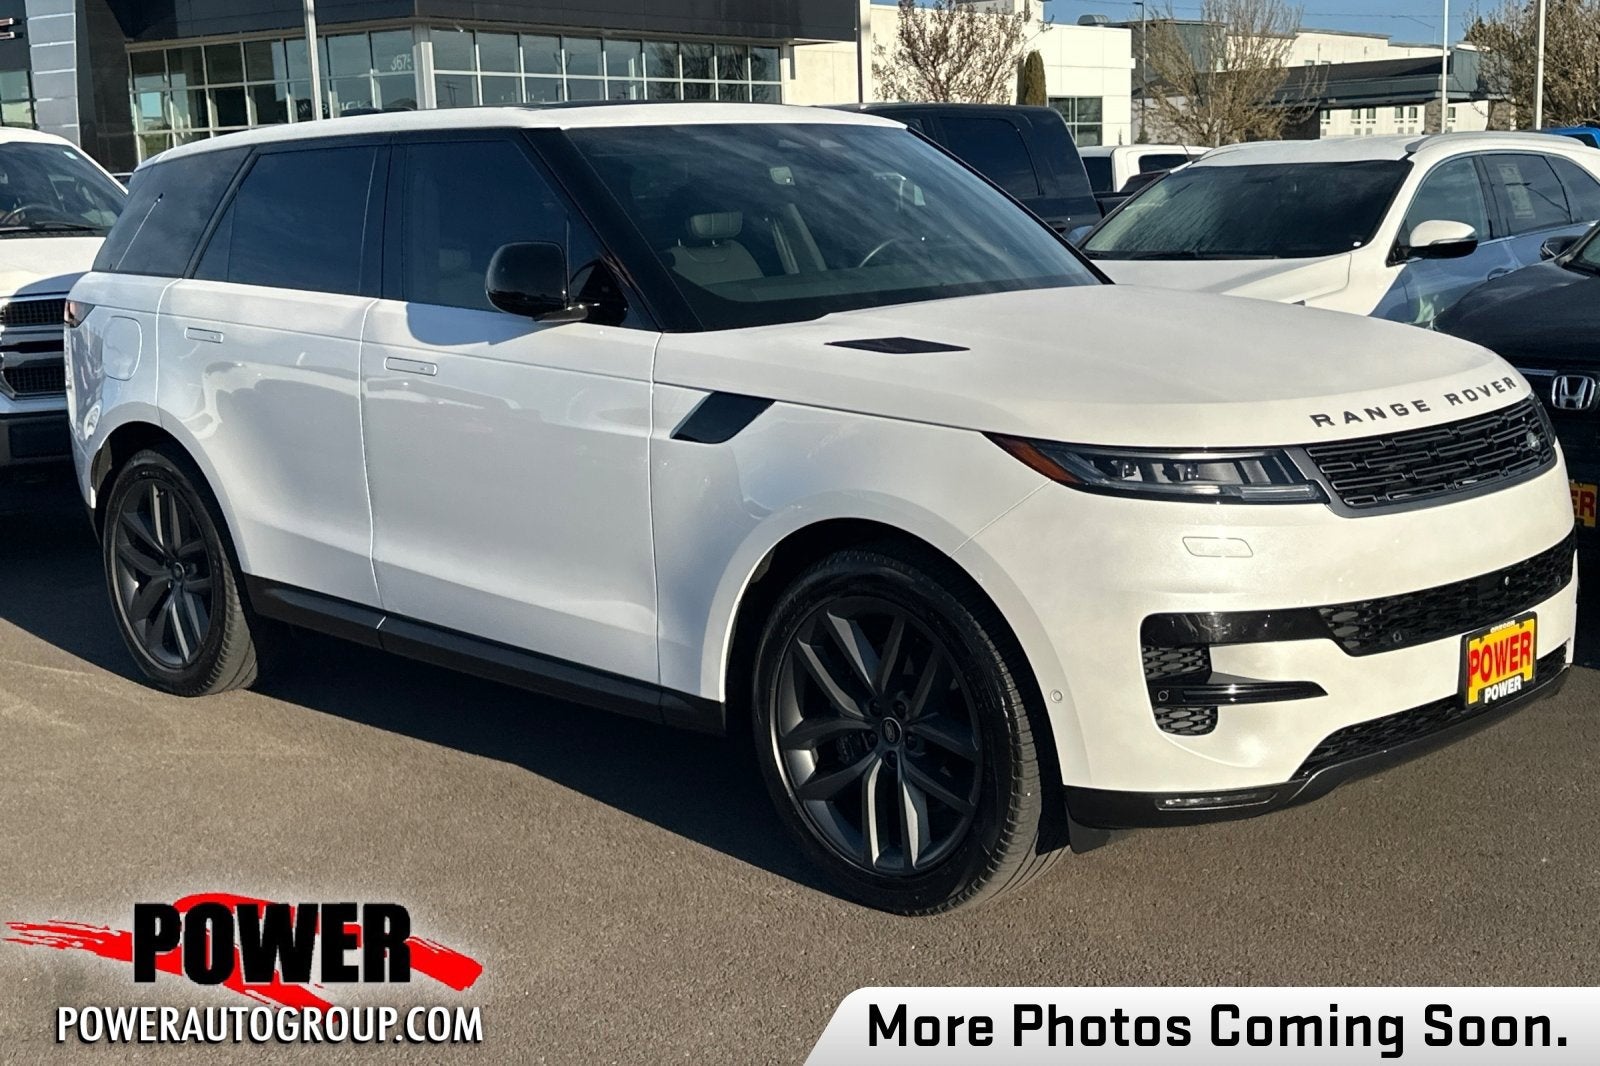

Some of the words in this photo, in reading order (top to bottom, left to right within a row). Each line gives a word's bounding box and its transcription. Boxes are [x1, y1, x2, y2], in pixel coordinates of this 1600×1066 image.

[1309, 399, 1431, 428] RANGE
[1445, 376, 1517, 406] ROVER
[1468, 631, 1531, 687] POWER
[1484, 675, 1521, 703] POWER
